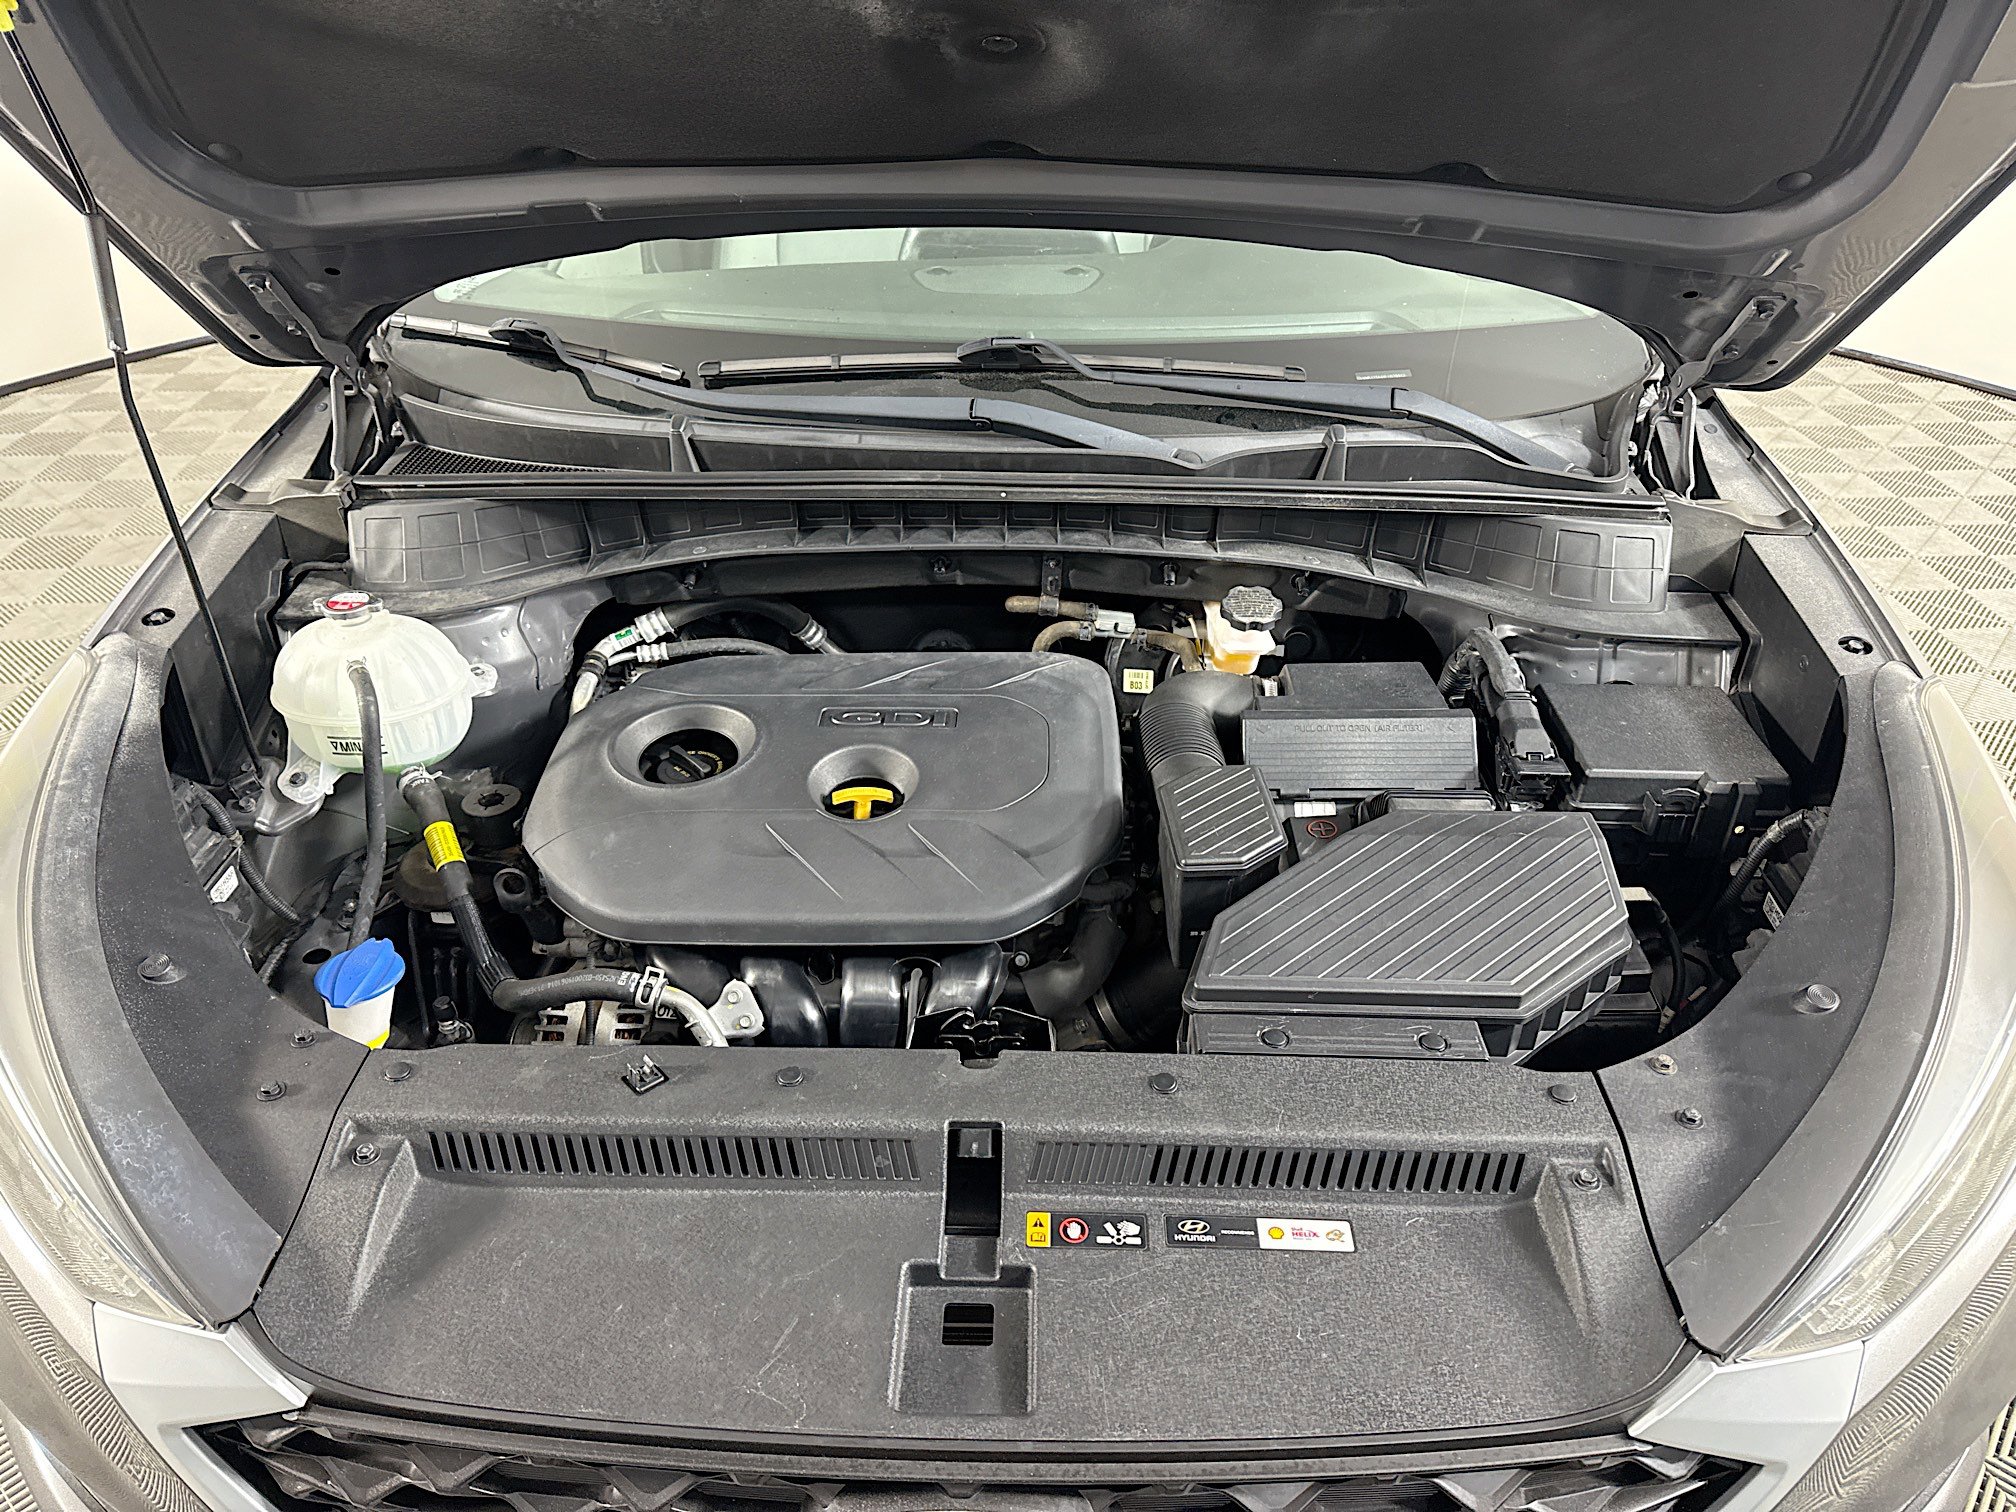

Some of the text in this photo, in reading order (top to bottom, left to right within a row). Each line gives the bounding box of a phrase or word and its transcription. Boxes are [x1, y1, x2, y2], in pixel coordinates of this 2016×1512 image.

[830, 711, 947, 727] GDI
[1294, 724, 1316, 733] PULL
[1317, 724, 1334, 732] OUT
[1335, 724, 1346, 732] TO
[1347, 724, 1371, 732] OPEN
[339, 741, 363, 753] MIN
[1174, 1233, 1216, 1243] HYUNDAI
